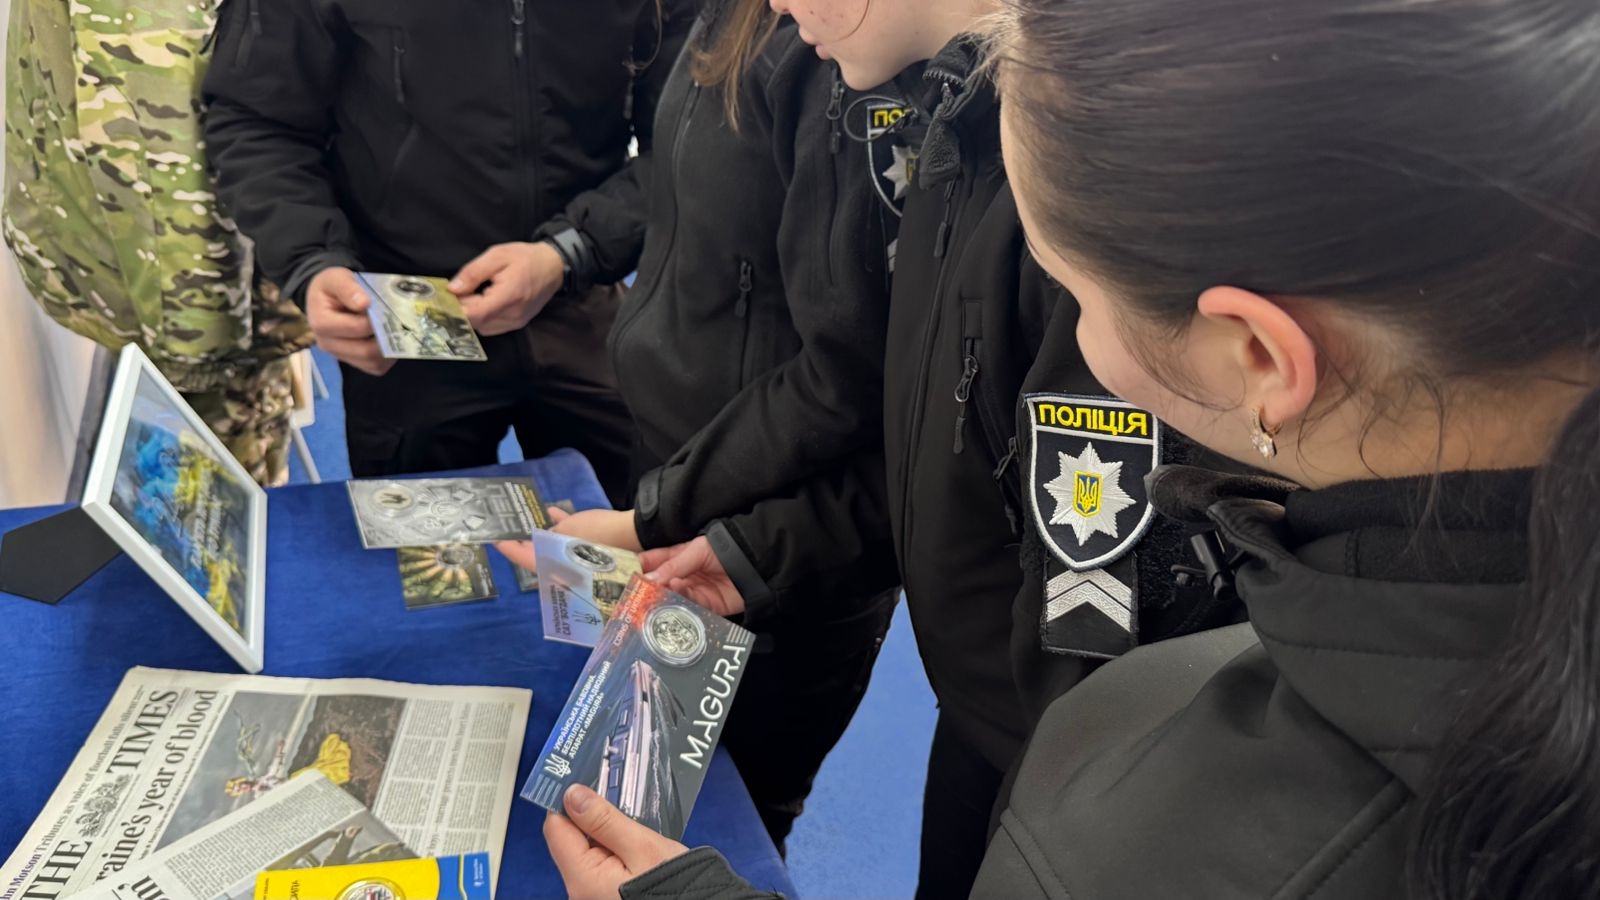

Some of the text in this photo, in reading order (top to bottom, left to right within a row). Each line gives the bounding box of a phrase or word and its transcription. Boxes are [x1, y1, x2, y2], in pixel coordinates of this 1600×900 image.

[874, 107, 913, 127] ПО
[1038, 404, 1148, 436] ПОЛІЦІЯ
[613, 623, 629, 646] COINS
[625, 611, 633, 624] OF
[170, 690, 218, 740] blood
[553, 707, 580, 752] УКРАЇНСЬКА
[561, 660, 612, 756] БЕЗПІЛОТНИЙ НАДВОДНИЙ
[680, 645, 746, 769] MAGURA
[165, 742, 190, 764] of
[568, 728, 587, 760] АПАРАТ
[20, 840, 93, 900] THE
[106, 690, 179, 774] TIMES
[138, 767, 176, 811] year
[10, 854, 42, 886] Motson
[34, 815, 68, 852] Tributes
[96, 814, 151, 881] raine's
